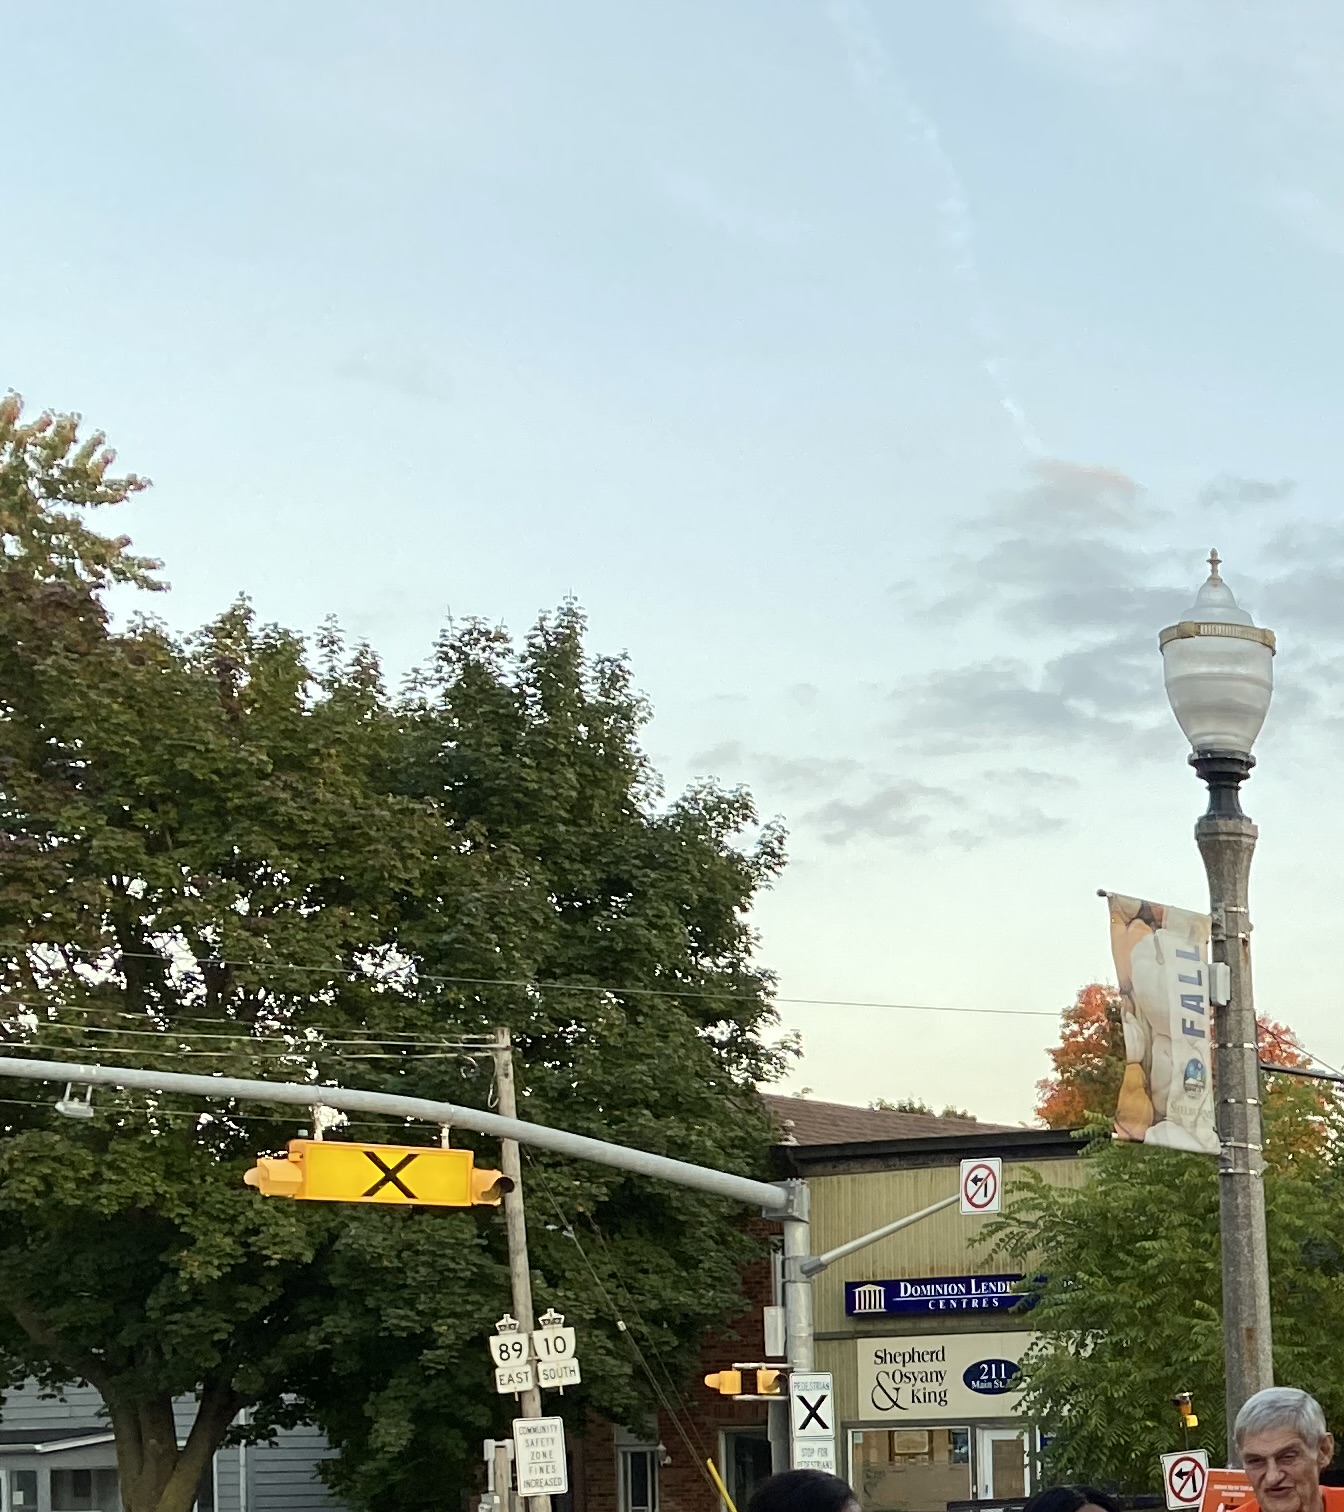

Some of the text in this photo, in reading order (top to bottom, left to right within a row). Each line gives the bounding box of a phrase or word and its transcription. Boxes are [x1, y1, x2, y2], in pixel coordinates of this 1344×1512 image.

[1176, 945, 1206, 1038] FALL
[899, 1281, 966, 1297] DOMINION
[928, 1297, 999, 1310] CENTRES
[499, 1342, 523, 1361] 89
[544, 1336, 566, 1355] 10
[873, 1345, 946, 1367] Shepherd
[499, 1371, 530, 1386] EAST
[542, 1366, 576, 1380] SOUTH
[891, 1369, 947, 1386] Osyany
[980, 1363, 1006, 1379] 211
[871, 1370, 948, 1411] & King
[971, 1380, 992, 1389] Main
[519, 1424, 558, 1435] COMMUNITY
[525, 1437, 555, 1448] SAFETY
[530, 1450, 553, 1460] ZONE
[529, 1465, 556, 1475] FINES
[523, 1477, 563, 1488] INCREASED
